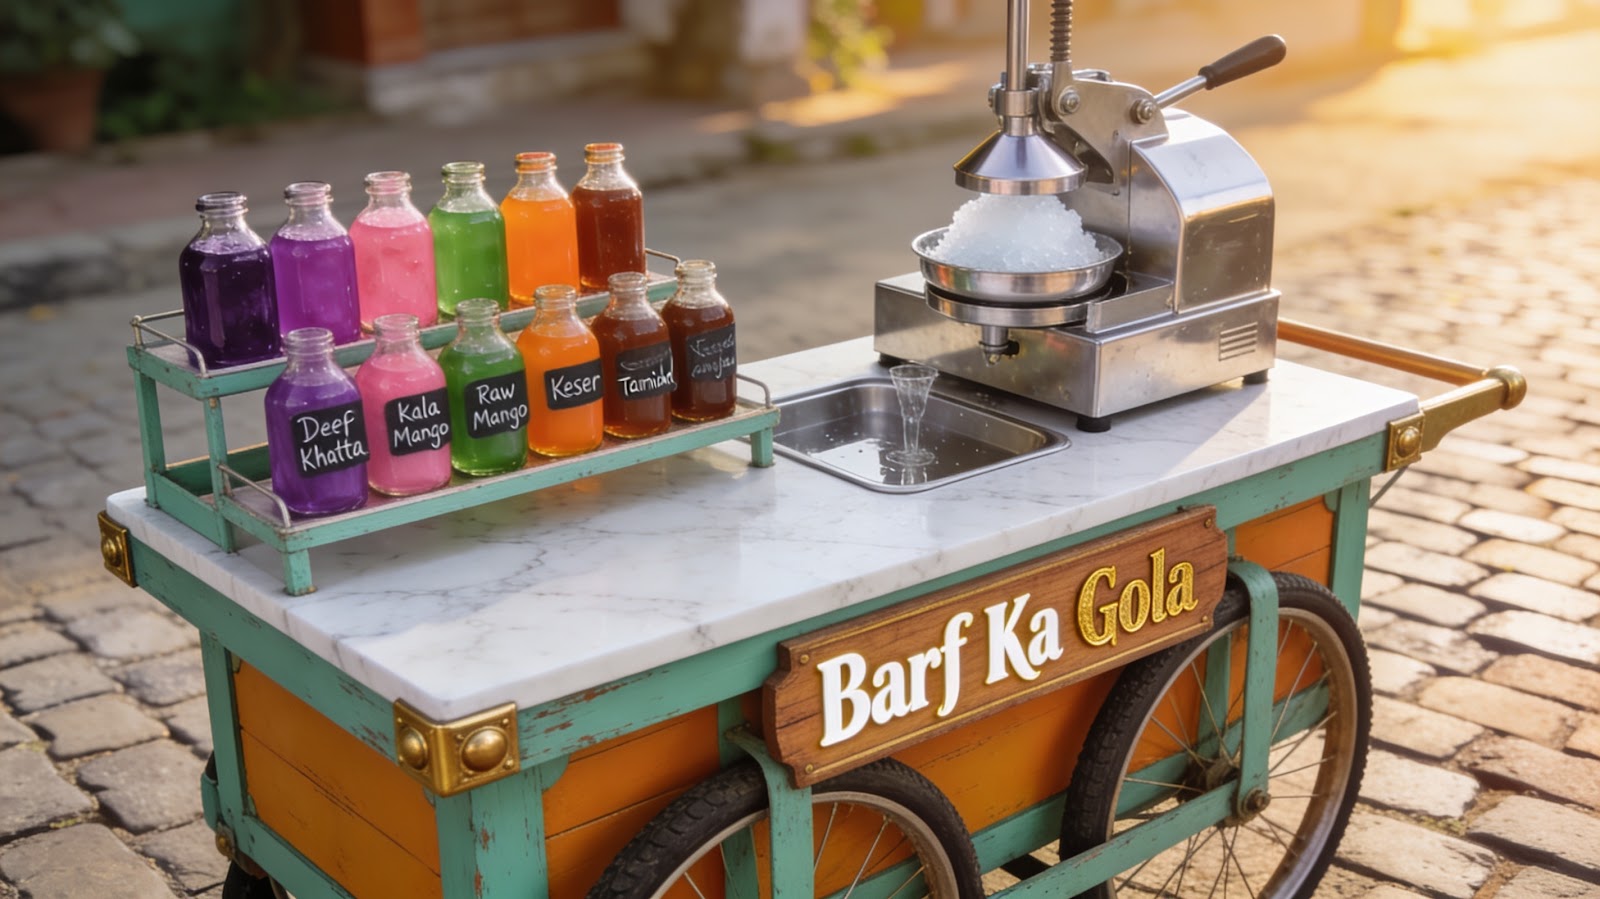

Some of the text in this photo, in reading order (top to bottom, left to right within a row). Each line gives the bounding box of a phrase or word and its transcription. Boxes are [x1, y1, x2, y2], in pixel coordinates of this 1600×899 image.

[476, 383, 516, 406] Raw
[551, 374, 601, 401] Keser
[398, 395, 441, 423] Kala
[473, 404, 528, 432] Mango
[297, 410, 355, 443] Deef
[394, 423, 450, 449] Mango
[301, 439, 369, 472] Khatta
[817, 547, 1199, 747] Barf Ka Gola
